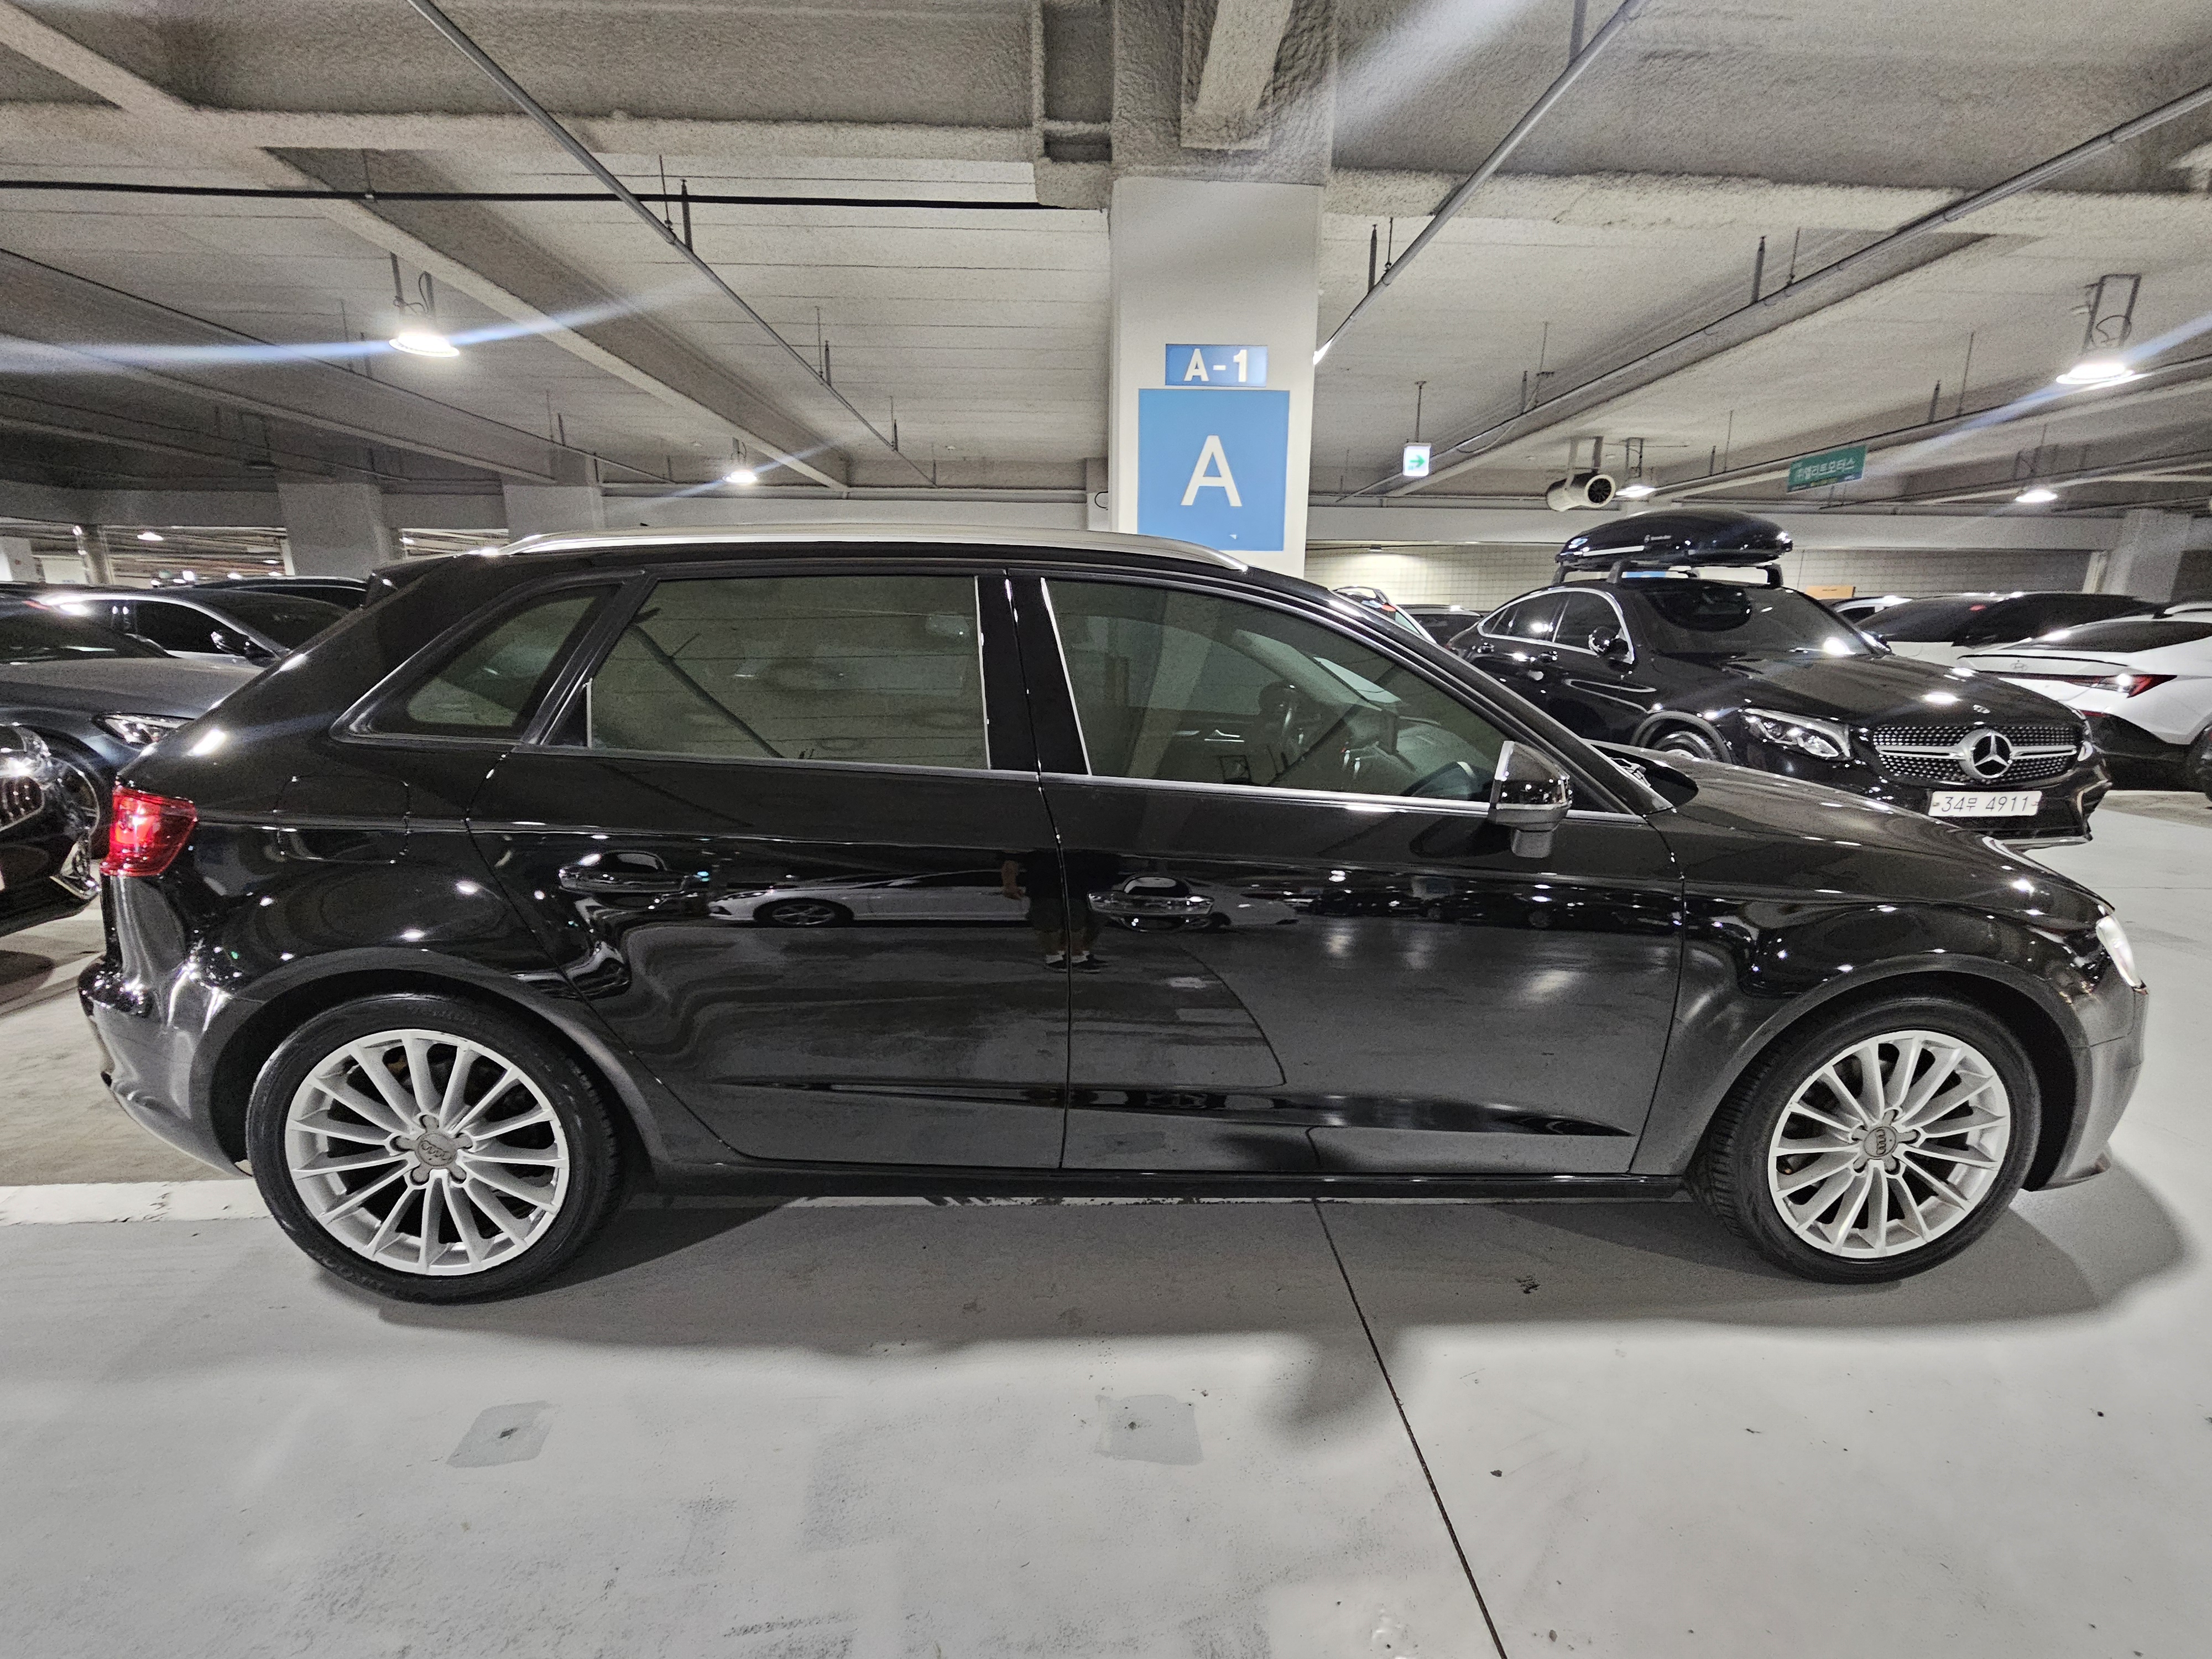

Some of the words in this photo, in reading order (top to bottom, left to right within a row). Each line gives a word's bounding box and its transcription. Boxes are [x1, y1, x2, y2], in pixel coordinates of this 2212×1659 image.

[1183, 348, 1248, 383] A-1
[1180, 435, 1243, 507] A
[1941, 796, 1978, 812] 34무
[1985, 796, 2028, 812] 4911
